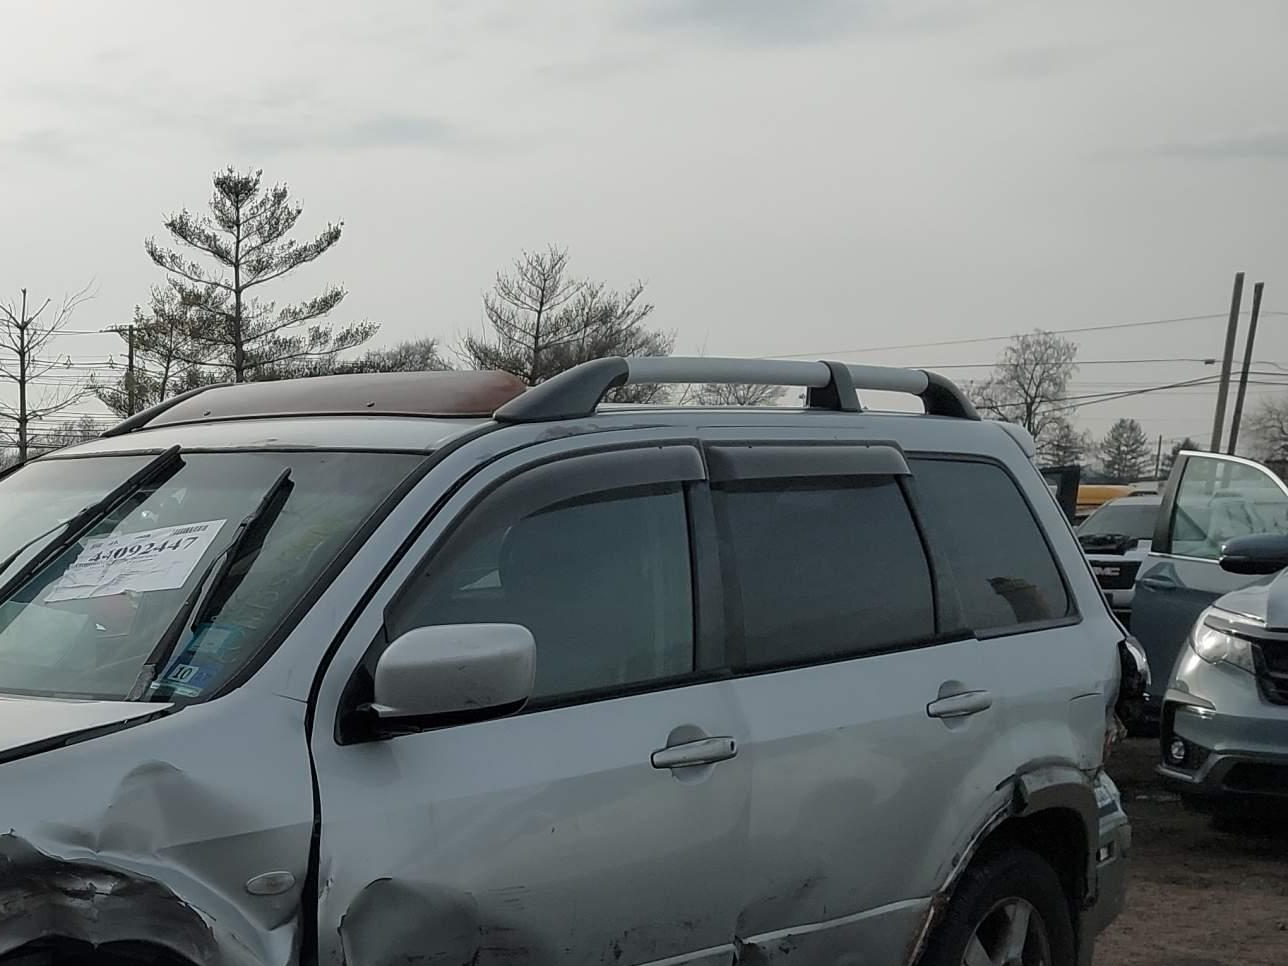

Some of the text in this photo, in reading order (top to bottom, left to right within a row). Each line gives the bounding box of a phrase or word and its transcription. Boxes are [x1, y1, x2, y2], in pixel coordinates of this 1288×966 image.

[88, 536, 199, 562] 44092447
[1092, 566, 1121, 576] MC
[172, 666, 193, 680] 10
